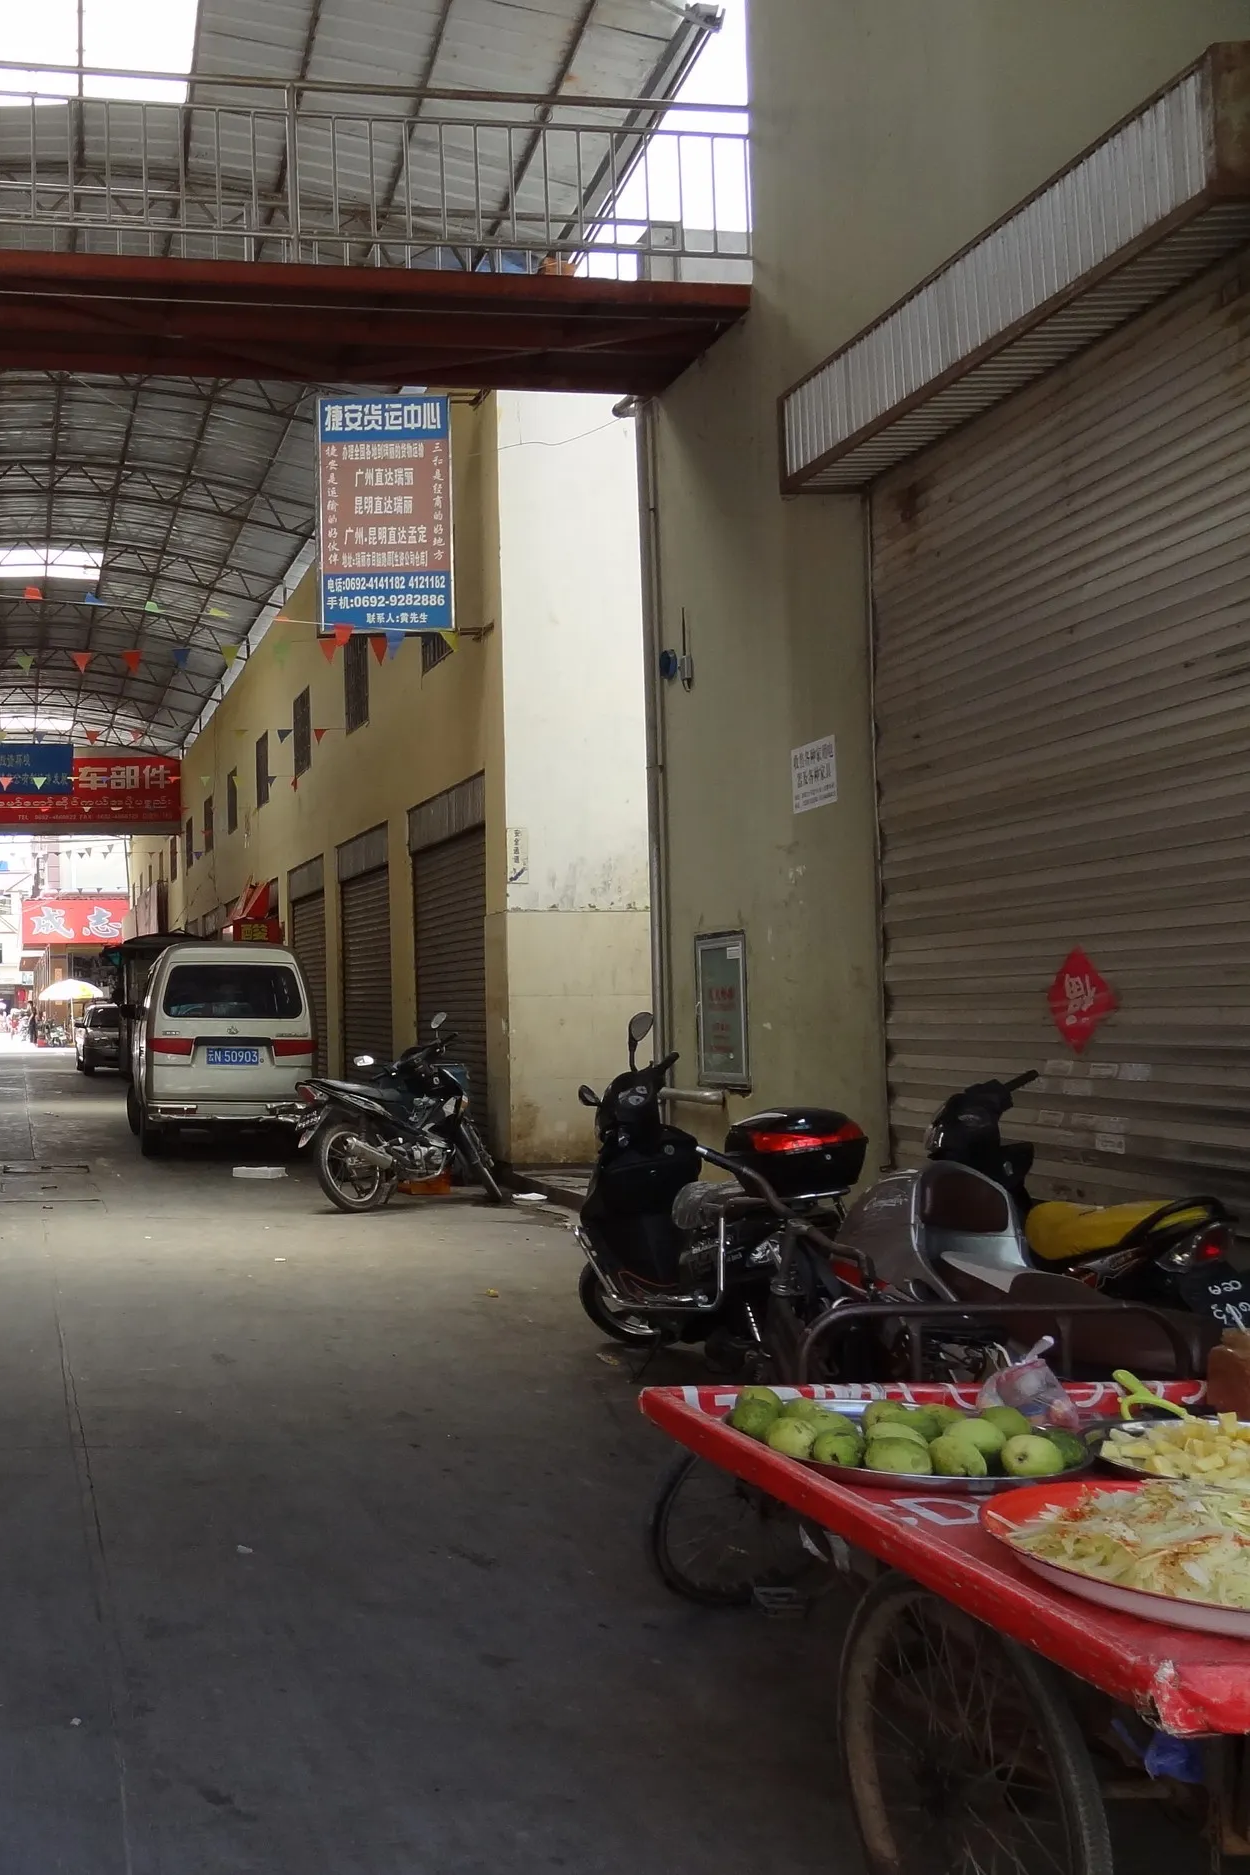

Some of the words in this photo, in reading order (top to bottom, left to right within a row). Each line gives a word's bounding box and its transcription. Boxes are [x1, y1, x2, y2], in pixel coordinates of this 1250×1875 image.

[324, 402, 442, 433] 捷安货运中心
[354, 467, 415, 488] 广州直达瑞丽
[354, 495, 414, 515] 昆明直达瑞丽
[78, 763, 171, 792] 车部件
[224, 1050, 258, 1063] 50903
